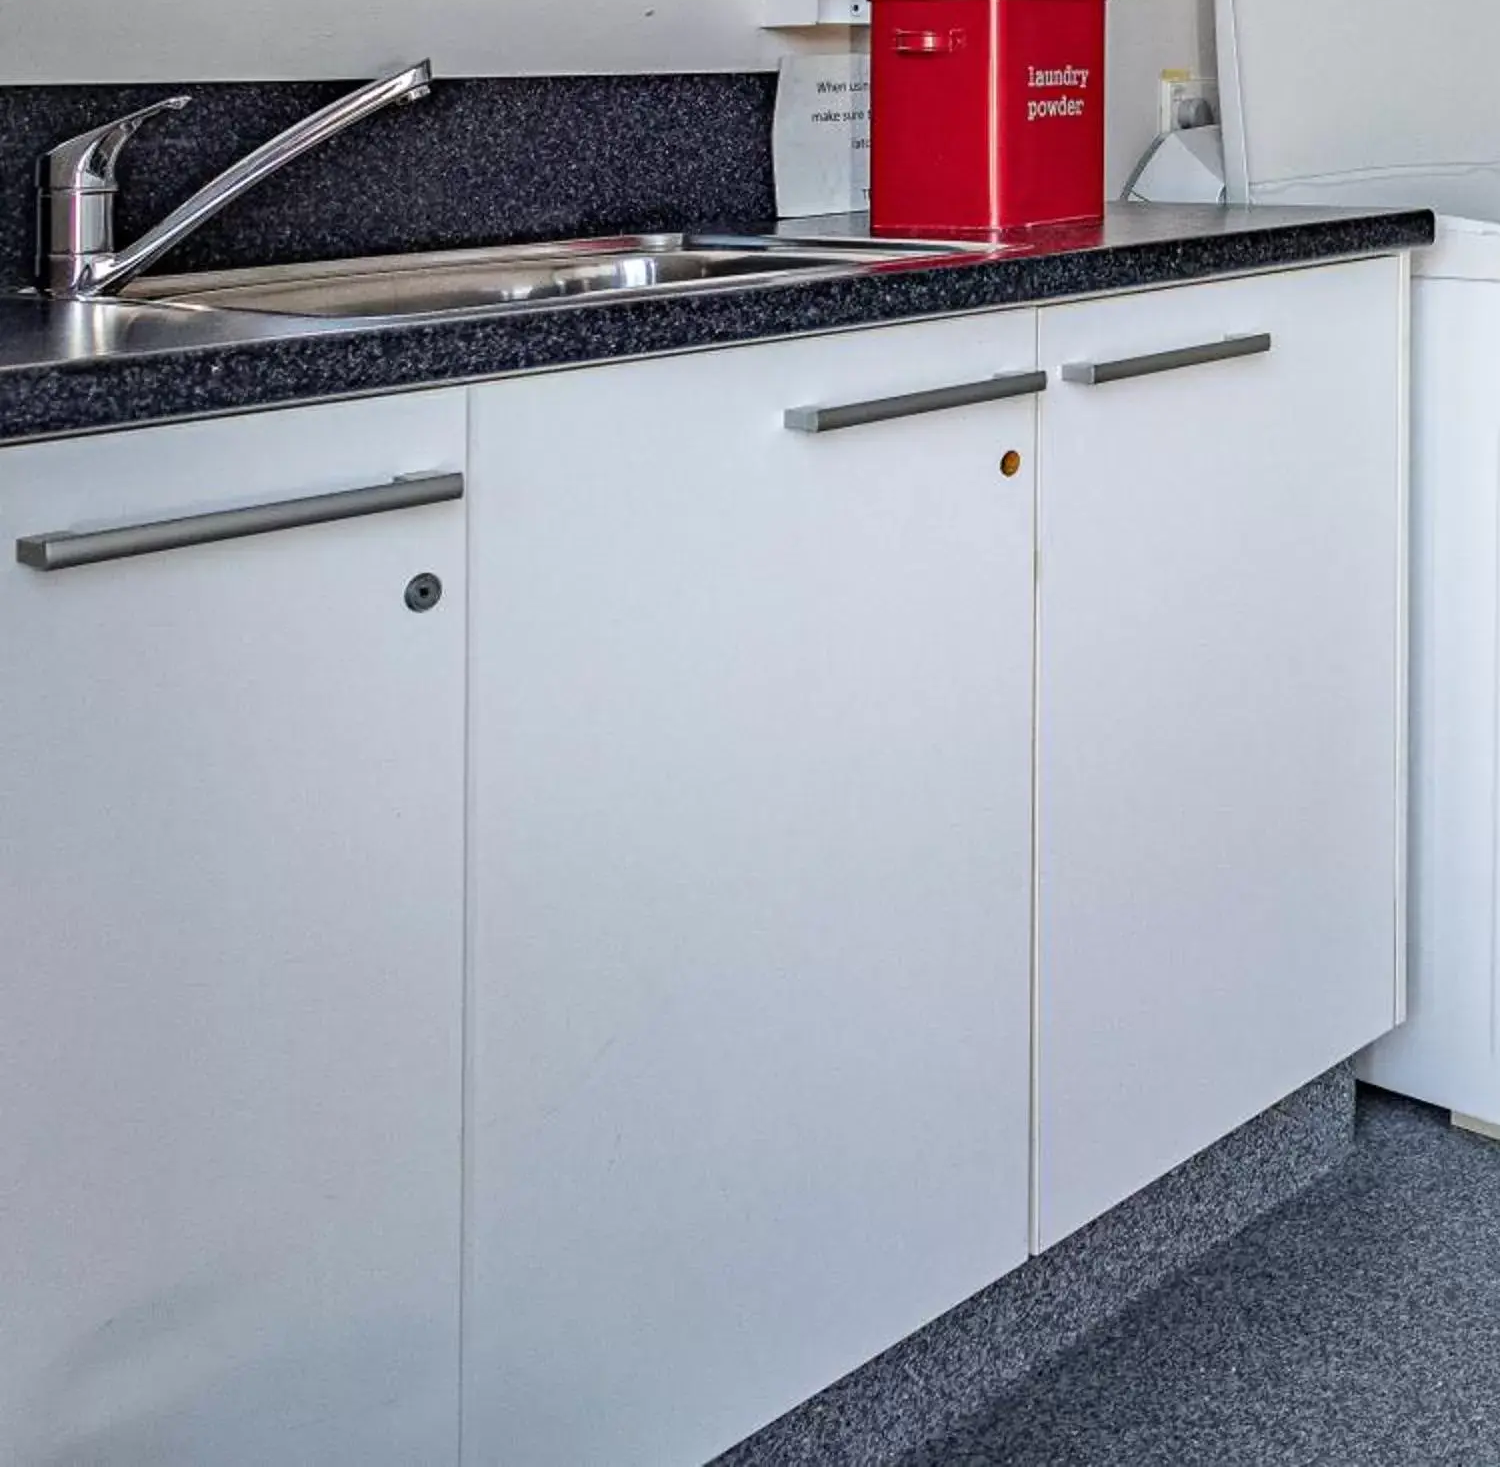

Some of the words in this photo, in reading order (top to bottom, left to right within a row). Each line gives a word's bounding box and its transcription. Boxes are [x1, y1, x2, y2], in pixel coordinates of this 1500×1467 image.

[1027, 64, 1089, 89] laundry
[811, 110, 840, 123] make
[1027, 94, 1085, 121] powder
